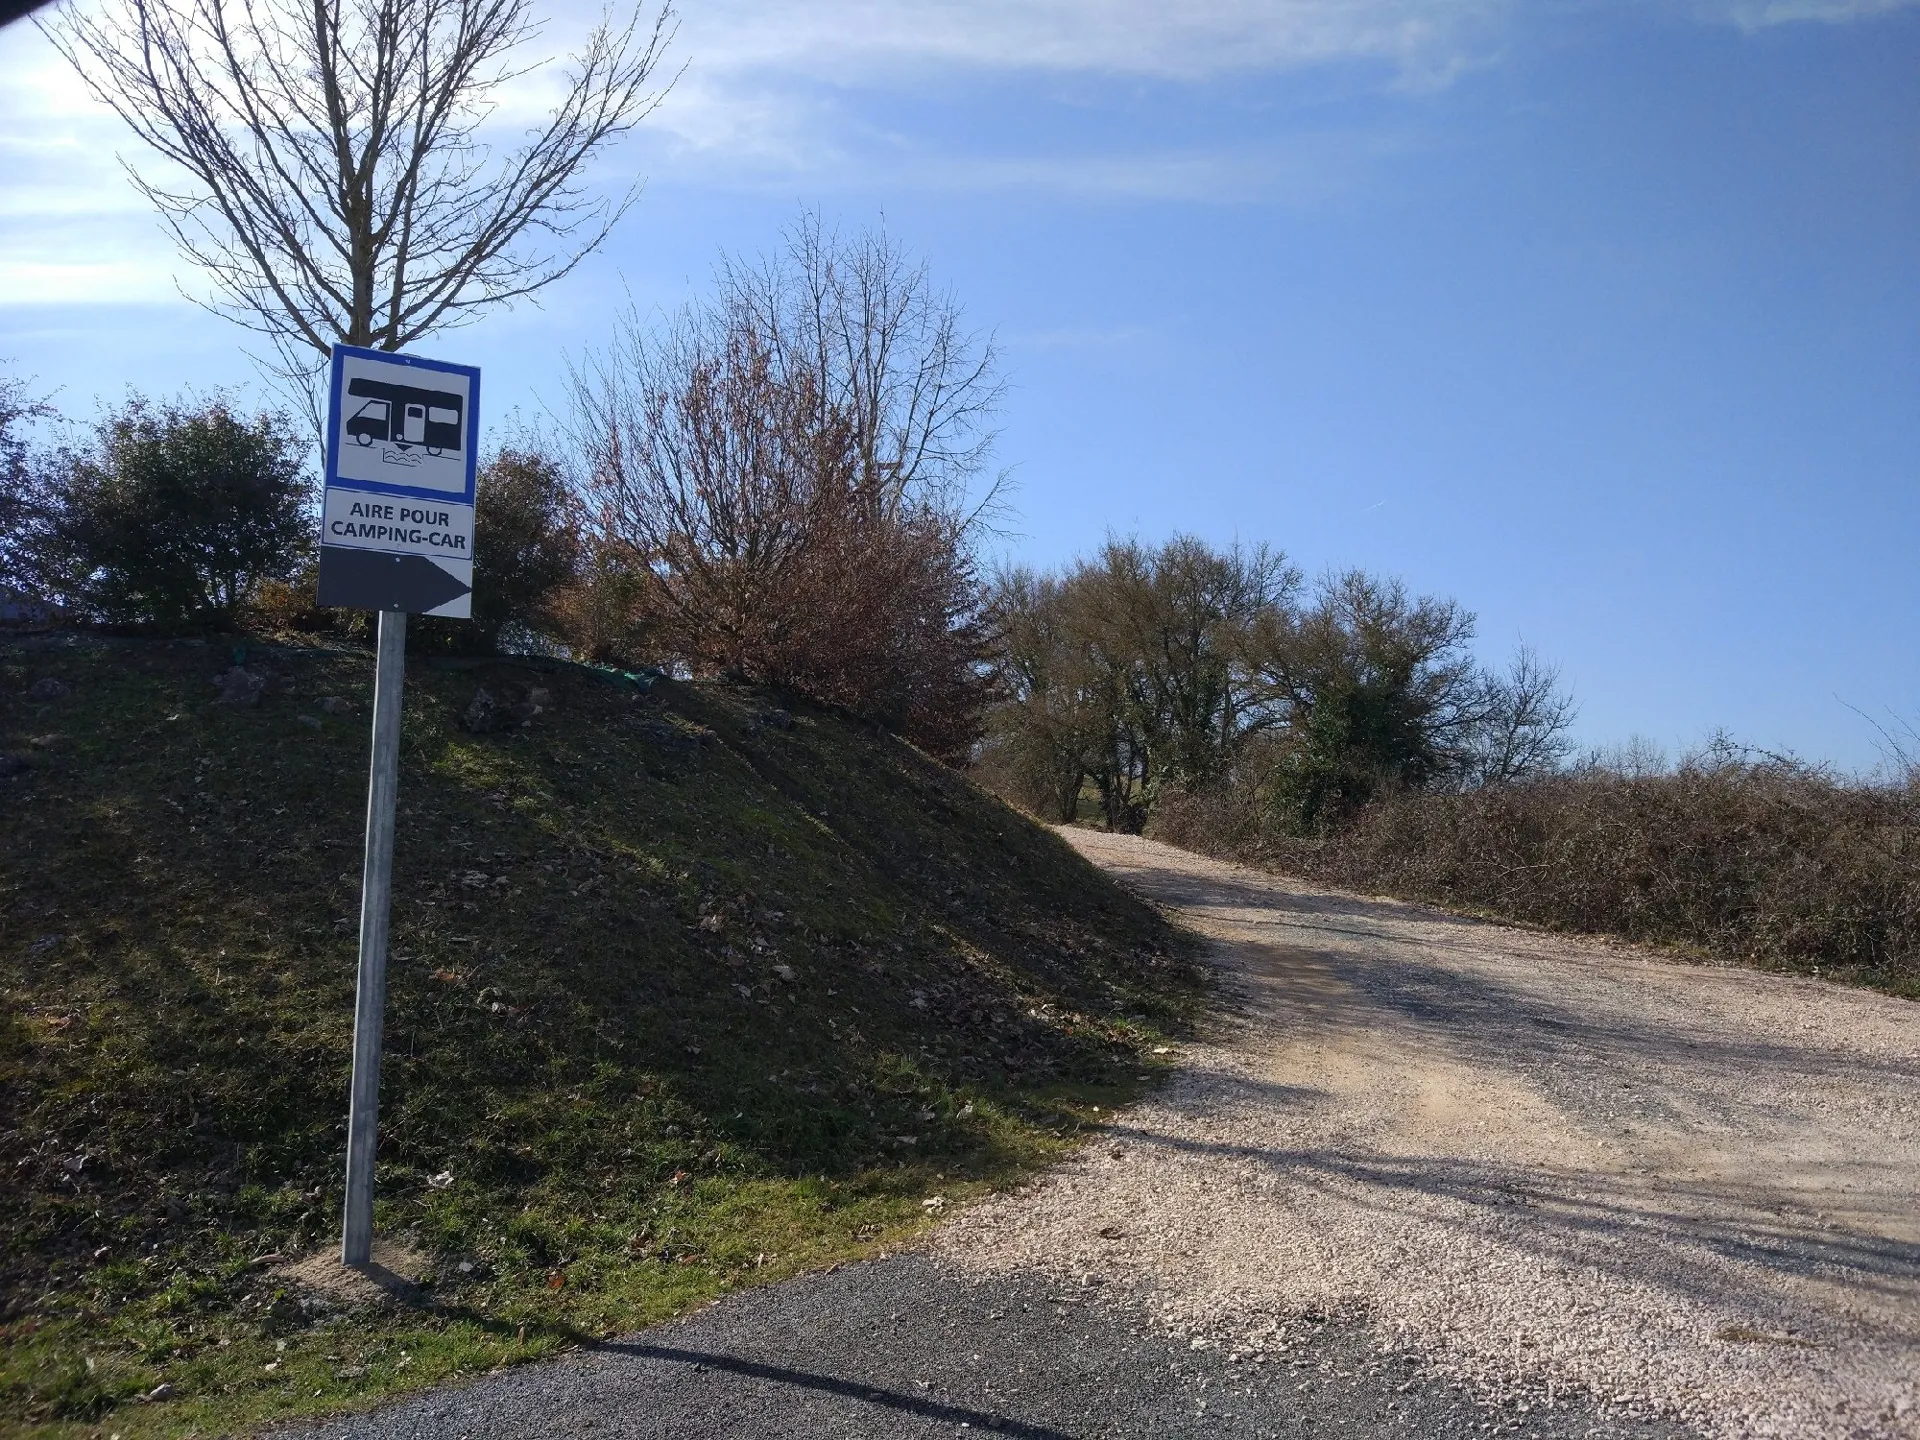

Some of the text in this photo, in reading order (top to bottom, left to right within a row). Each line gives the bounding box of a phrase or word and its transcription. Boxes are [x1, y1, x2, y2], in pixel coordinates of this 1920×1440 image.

[350, 502, 449, 527] AIRE POUR
[331, 520, 466, 549] CAMPING-CAR
